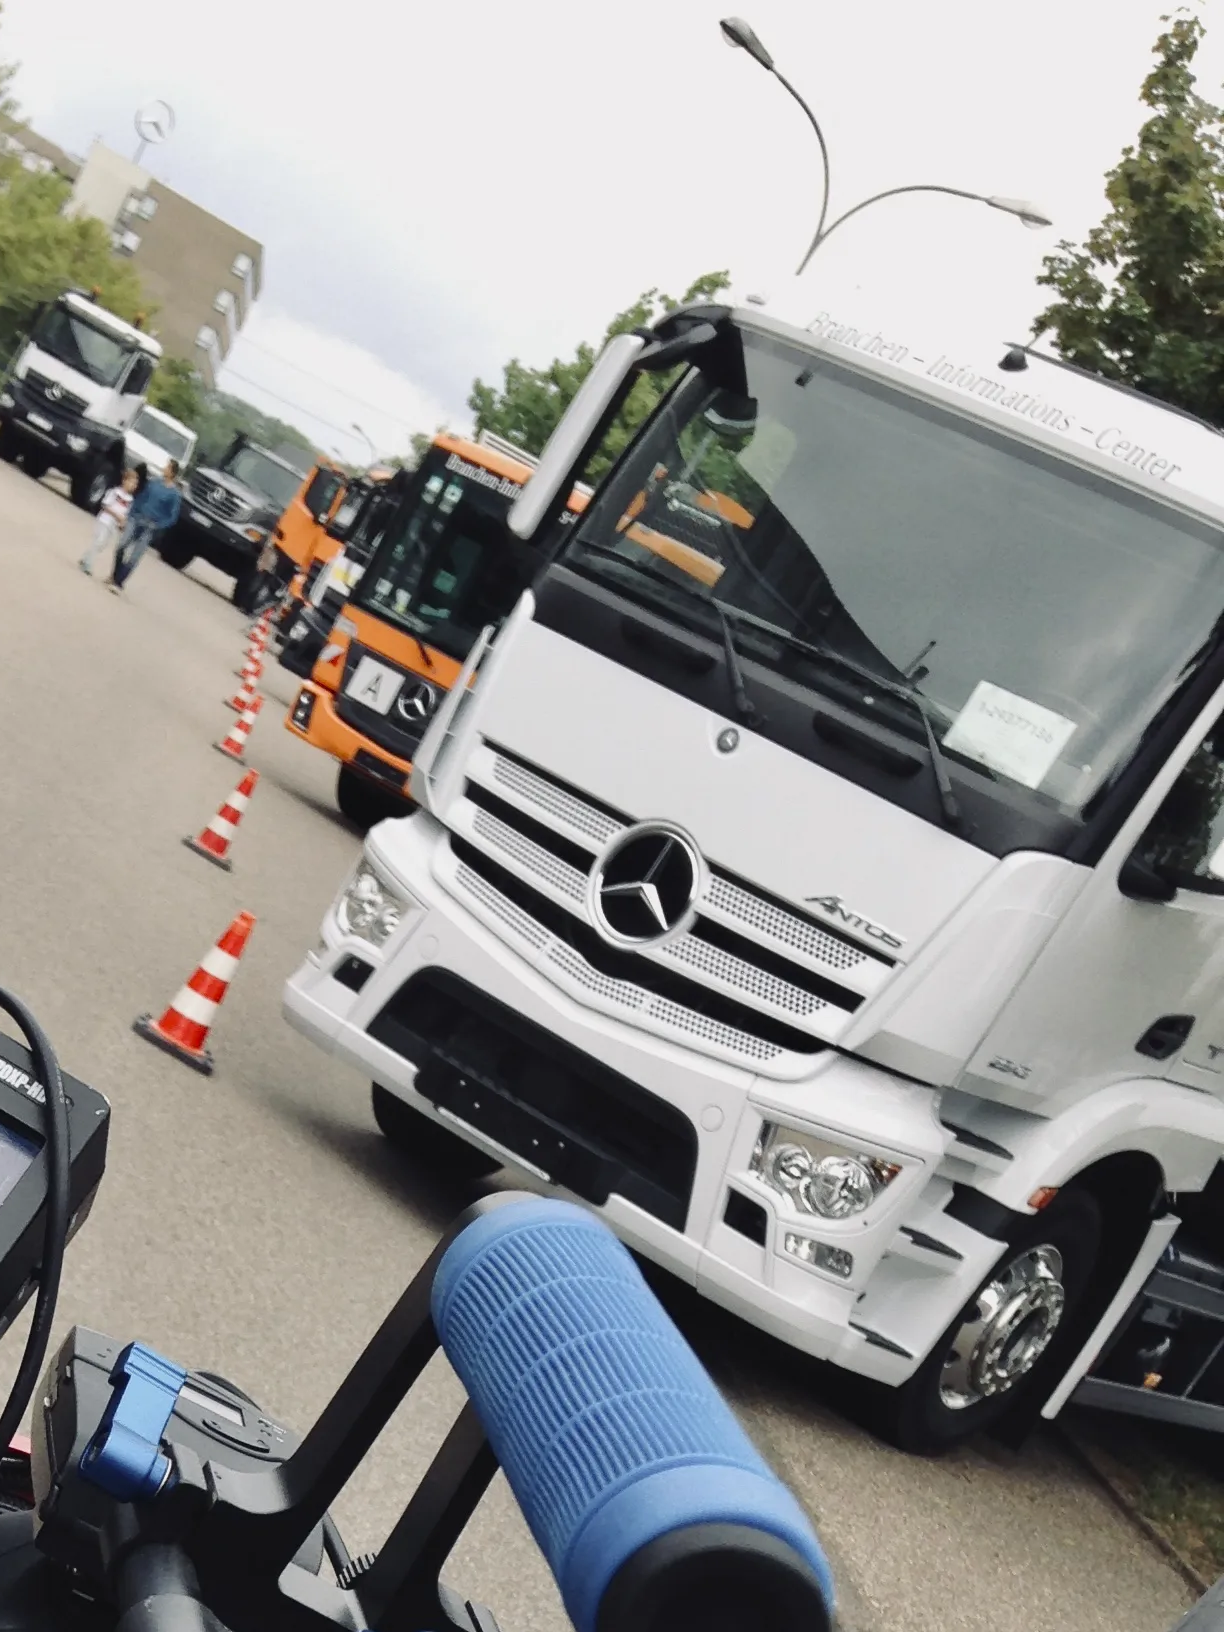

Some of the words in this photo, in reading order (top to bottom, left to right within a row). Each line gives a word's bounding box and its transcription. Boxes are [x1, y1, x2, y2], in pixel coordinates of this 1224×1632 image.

[805, 311, 909, 363] Branchen
[926, 355, 1076, 431] Informations
[1095, 426, 1182, 481] Center
[360, 673, 384, 702] A
